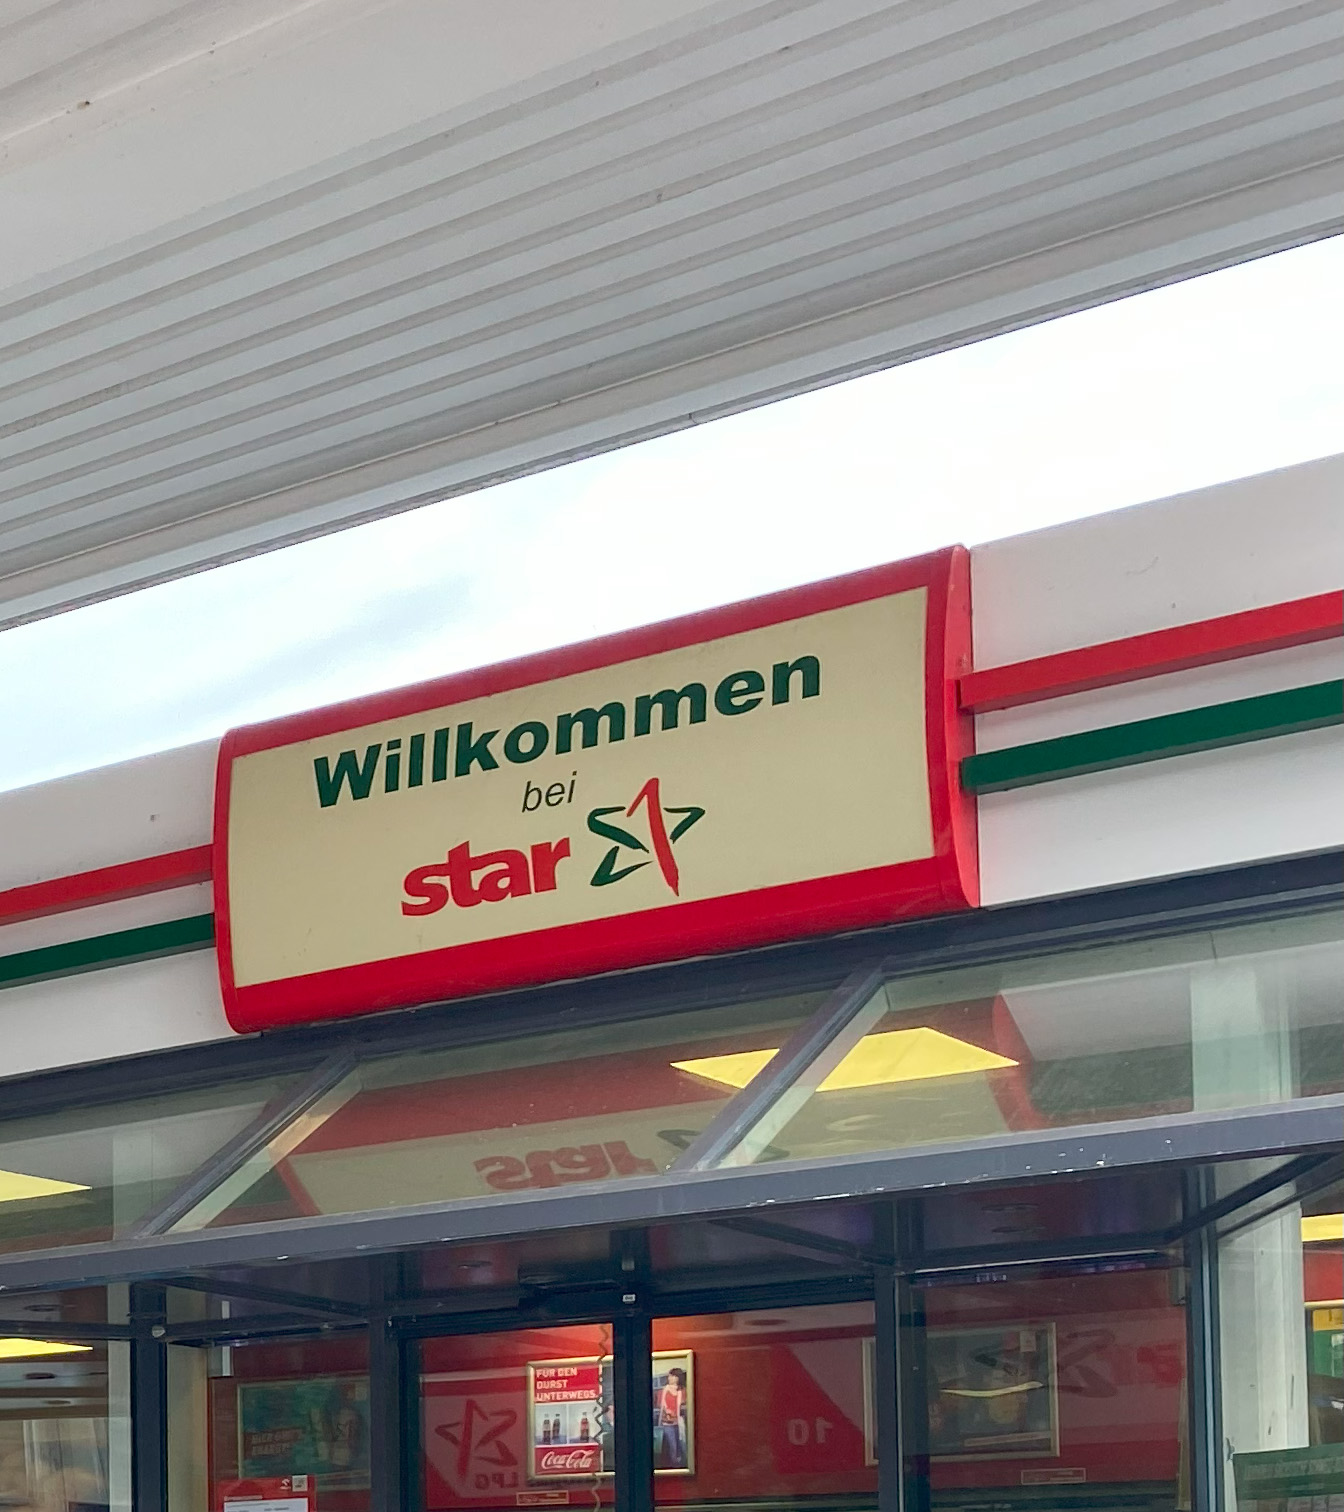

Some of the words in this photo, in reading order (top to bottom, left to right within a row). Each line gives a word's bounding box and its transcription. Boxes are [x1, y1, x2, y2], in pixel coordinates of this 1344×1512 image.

[314, 653, 822, 808] Willkommen
[520, 772, 578, 814] bei
[401, 834, 571, 918] star
[536, 1379, 568, 1390] DURST
